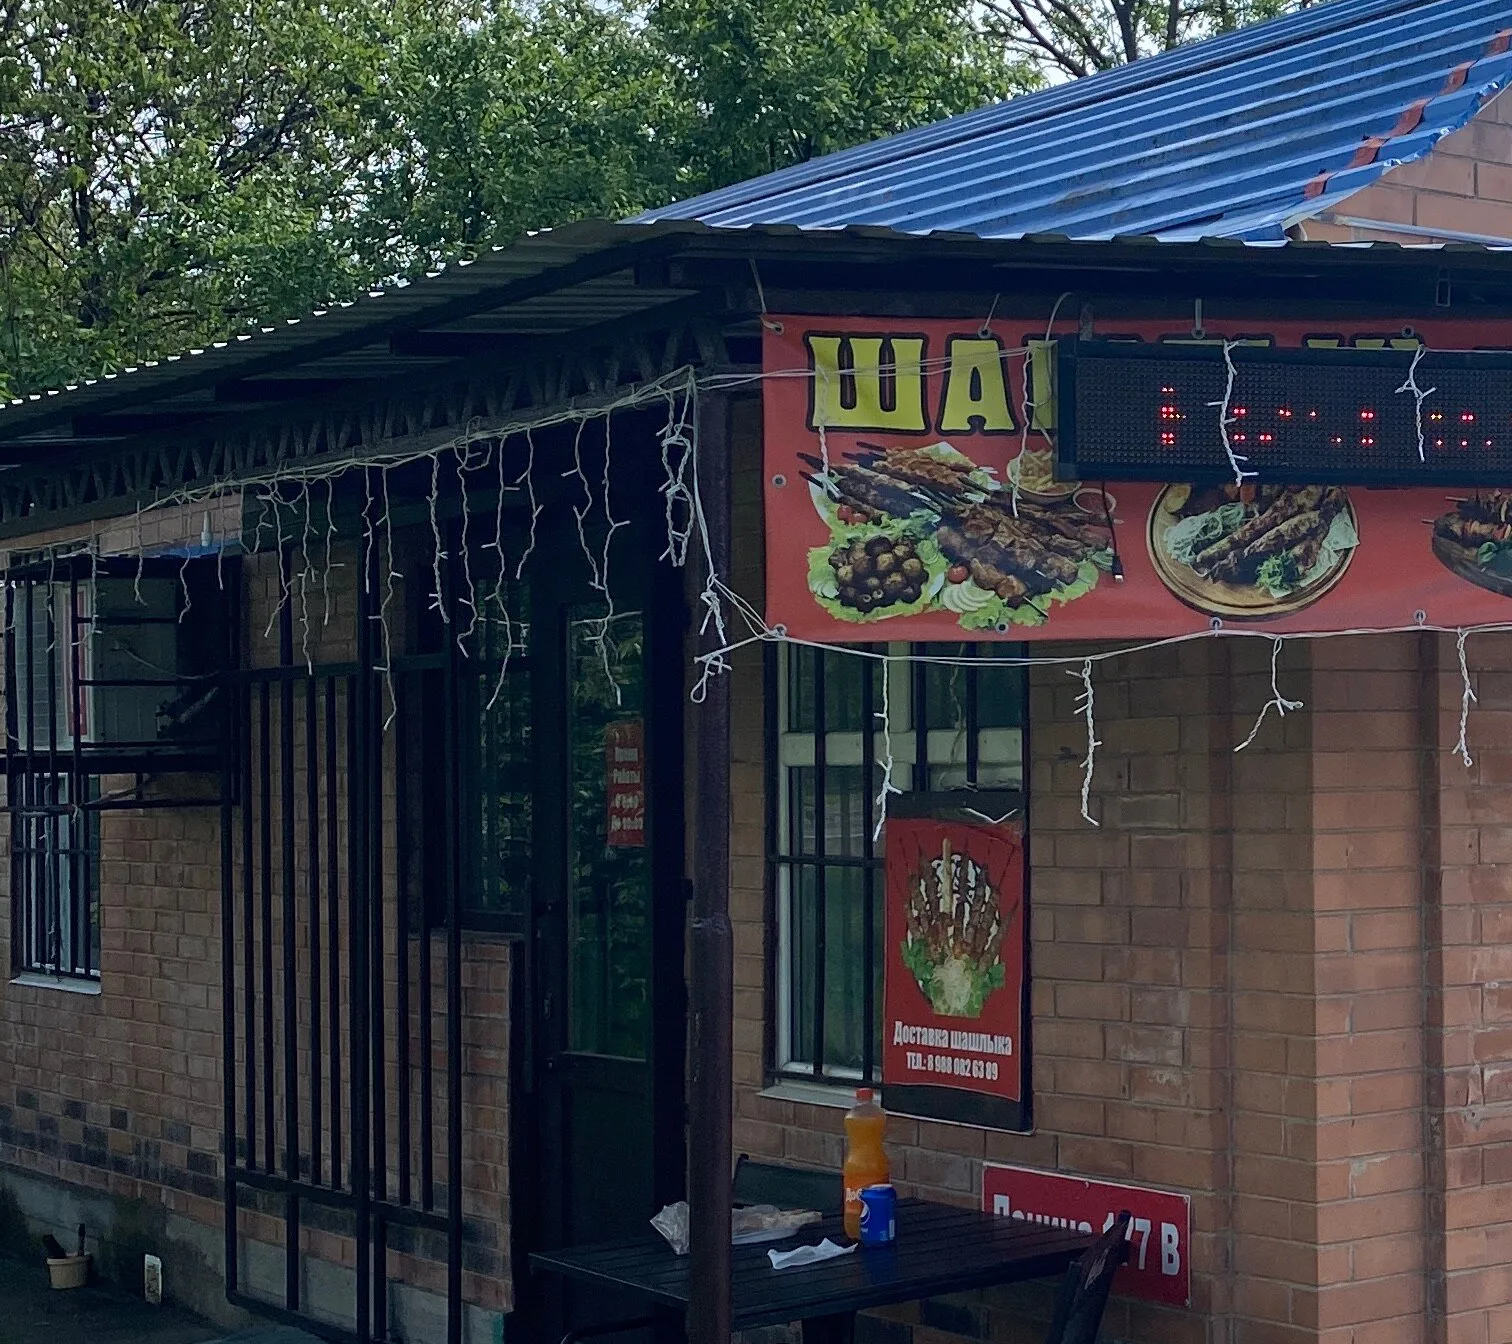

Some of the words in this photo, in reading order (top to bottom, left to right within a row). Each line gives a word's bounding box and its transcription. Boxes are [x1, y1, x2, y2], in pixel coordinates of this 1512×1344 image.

[893, 1020, 949, 1049] Доставка
[950, 1030, 1012, 1056] шашлыка
[927, 1054, 934, 1072] 8
